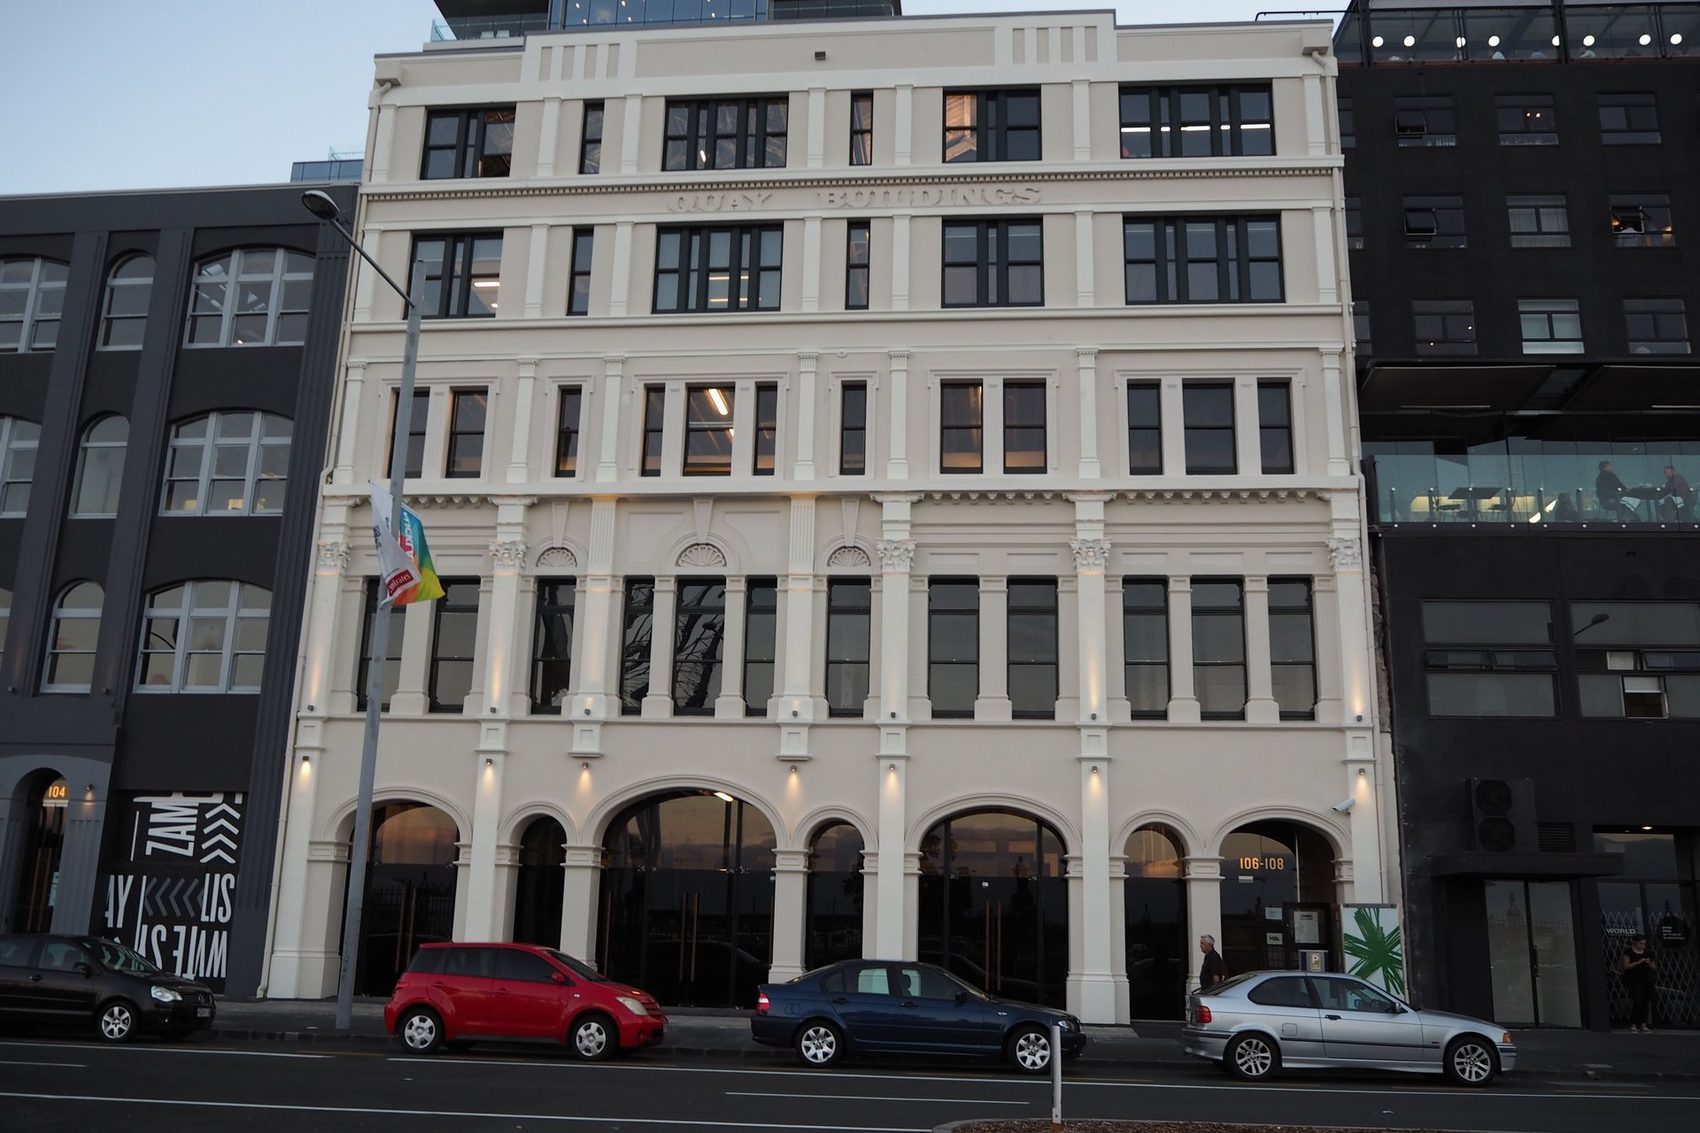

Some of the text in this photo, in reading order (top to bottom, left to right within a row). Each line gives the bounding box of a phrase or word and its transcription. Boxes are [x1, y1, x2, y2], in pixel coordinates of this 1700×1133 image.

[667, 186, 1042, 213] QUAY BUILDINGS
[48, 785, 66, 798] 104
[1239, 857, 1284, 870] 106-108
